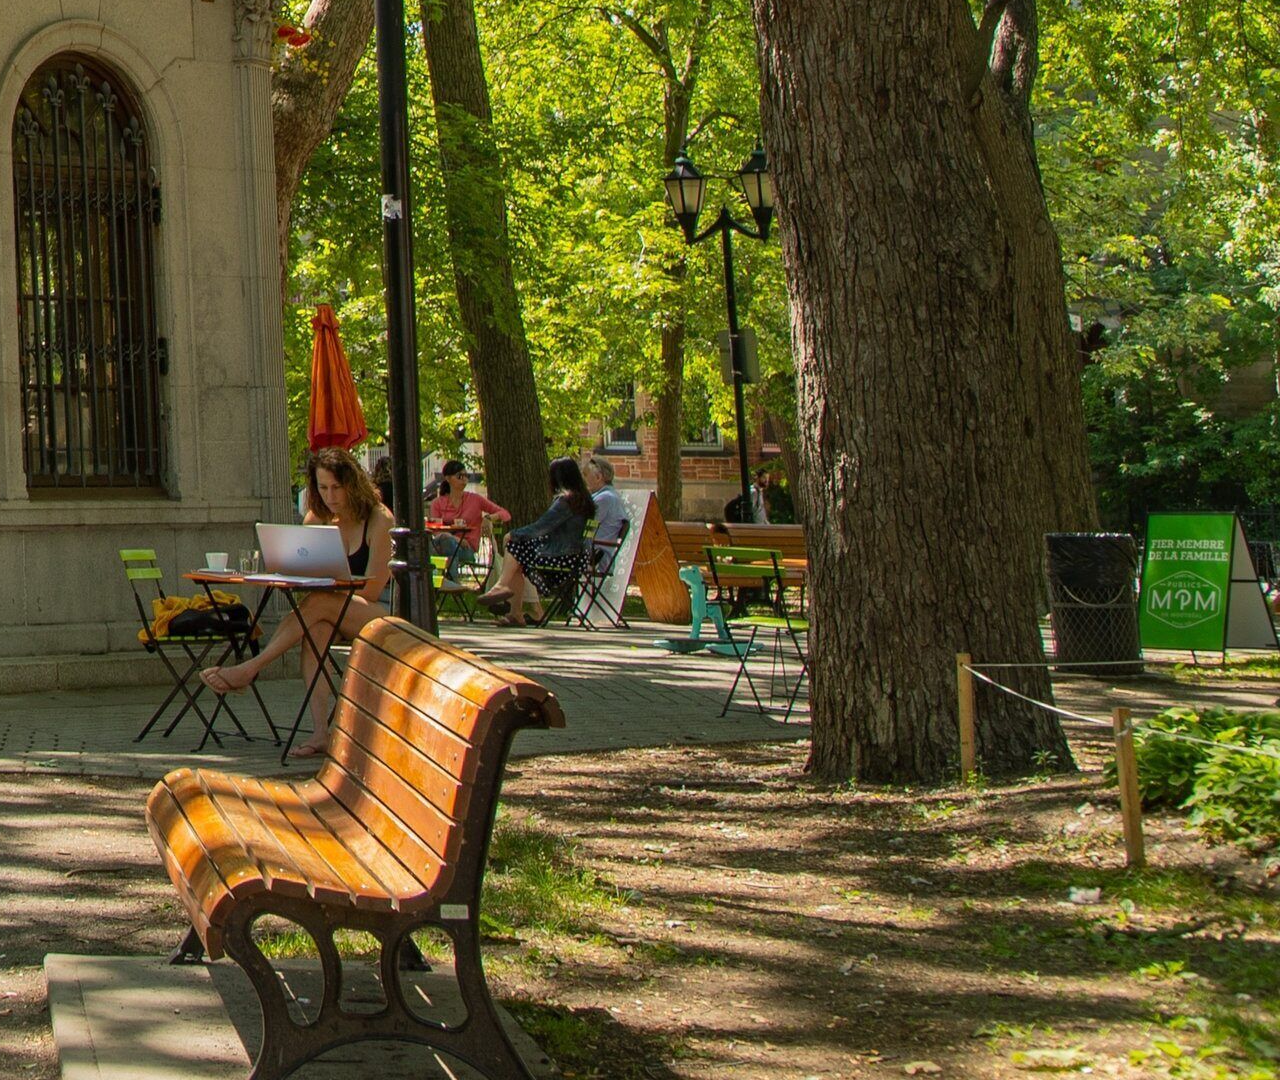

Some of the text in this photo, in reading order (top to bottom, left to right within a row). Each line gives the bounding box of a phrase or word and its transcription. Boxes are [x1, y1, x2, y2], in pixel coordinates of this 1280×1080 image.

[1151, 539, 1224, 549] FIER MEMBRE
[1148, 550, 1228, 562] DE LA FAMILLE
[1167, 581, 1201, 589] PUBLICS
[1151, 589, 1216, 611] MPM
